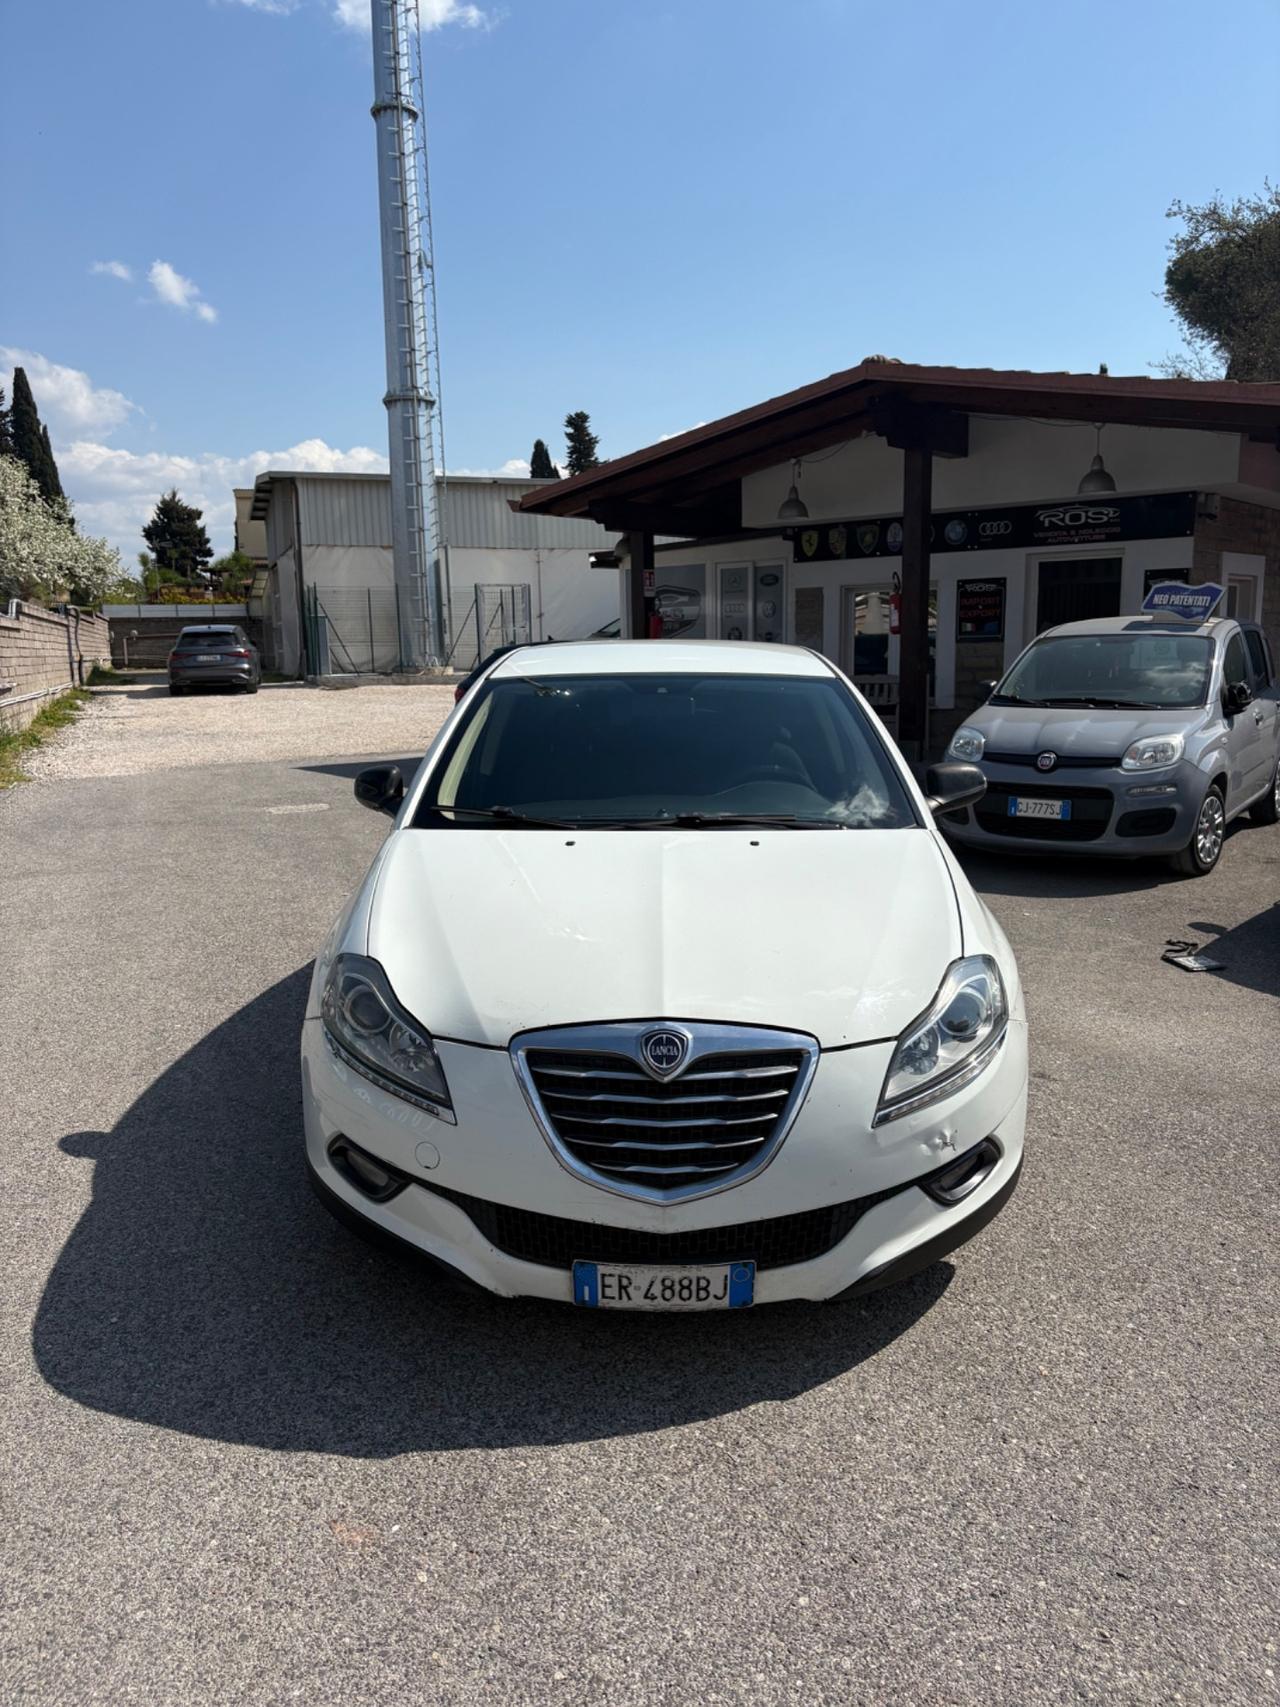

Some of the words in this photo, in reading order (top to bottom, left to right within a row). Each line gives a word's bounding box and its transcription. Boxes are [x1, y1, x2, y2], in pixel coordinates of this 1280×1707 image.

[1152, 594, 1168, 605] NEO
[1169, 594, 1211, 607] PATENTATI
[651, 1044, 679, 1056] LANCIA
